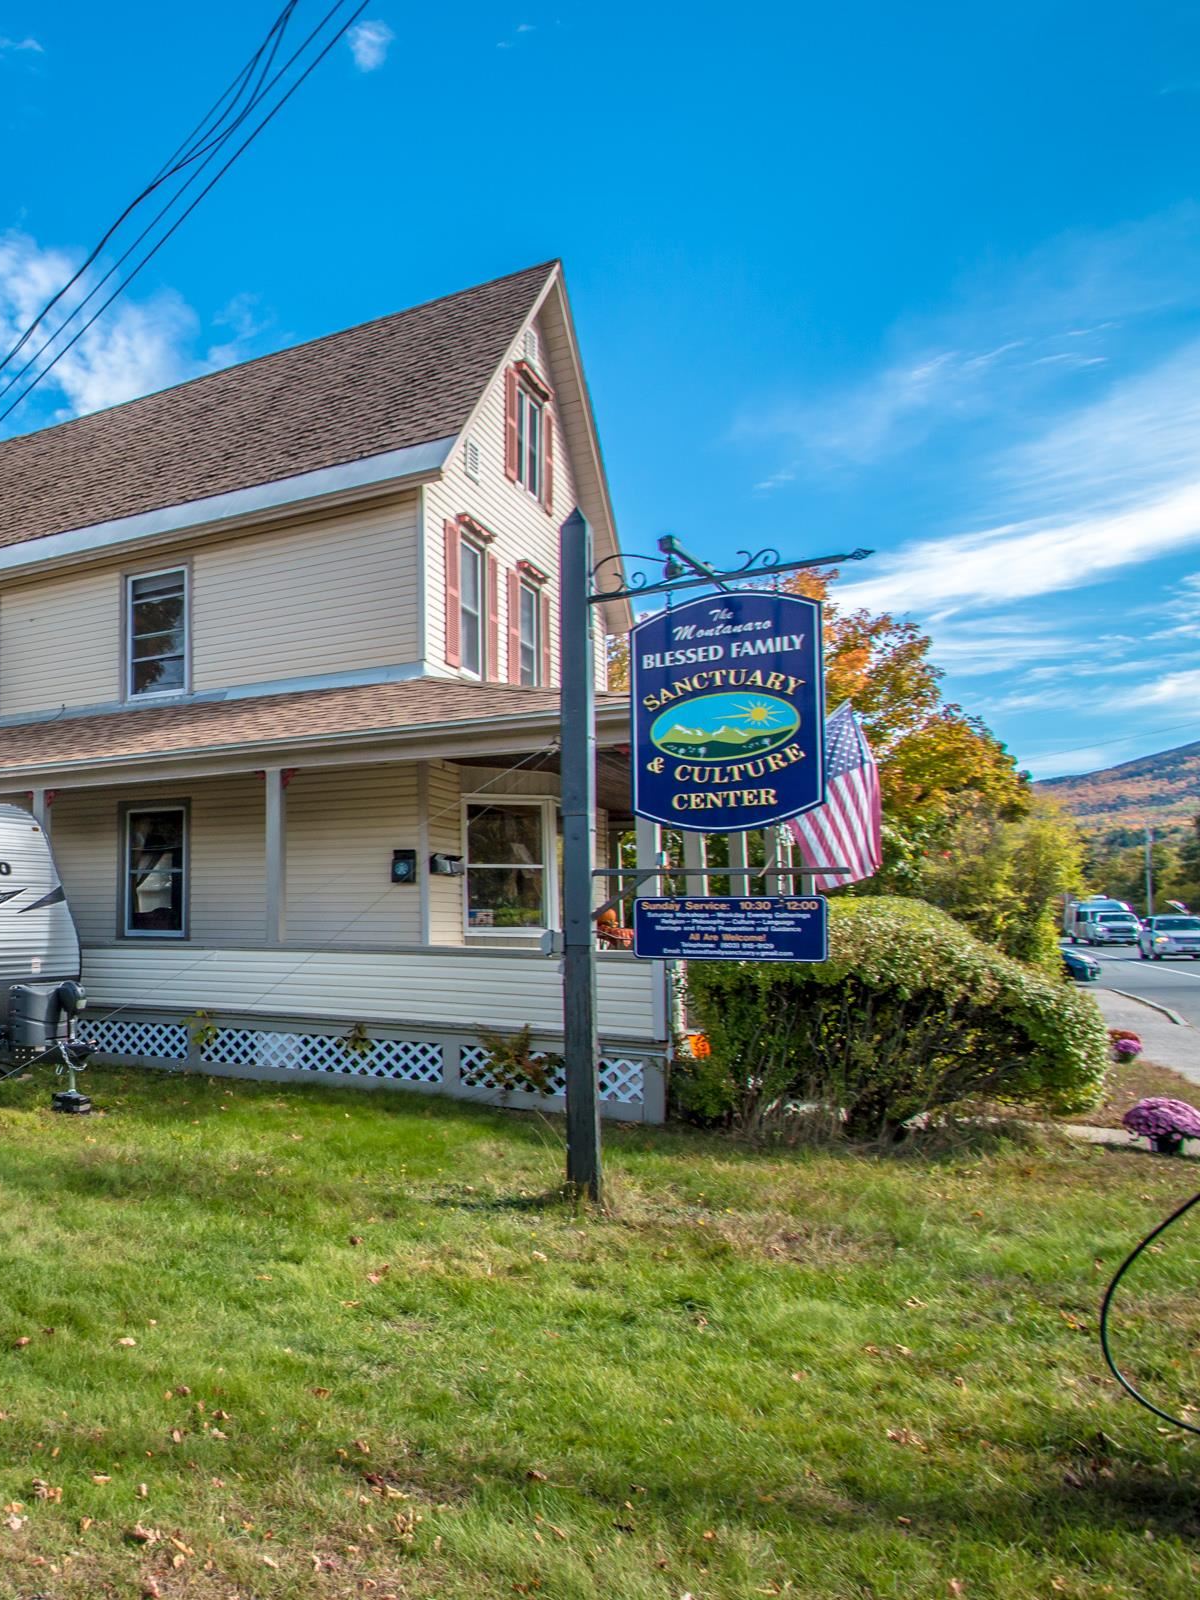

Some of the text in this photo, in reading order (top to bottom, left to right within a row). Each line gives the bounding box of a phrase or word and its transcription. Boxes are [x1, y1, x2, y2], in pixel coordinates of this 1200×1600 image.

[708, 608, 735, 622] The
[672, 620, 772, 641] Montanaro
[642, 634, 805, 670] BLESSED FAMILY
[642, 669, 806, 713] SANCTUARY
[646, 743, 806, 784] & CULTURE
[672, 788, 778, 811] CENTER
[641, 901, 681, 911] Sunday
[685, 901, 731, 910] Service:
[739, 901, 772, 910] 10:30
[785, 901, 819, 910] 12:00
[689, 933, 767, 942] All Are Welcome!
